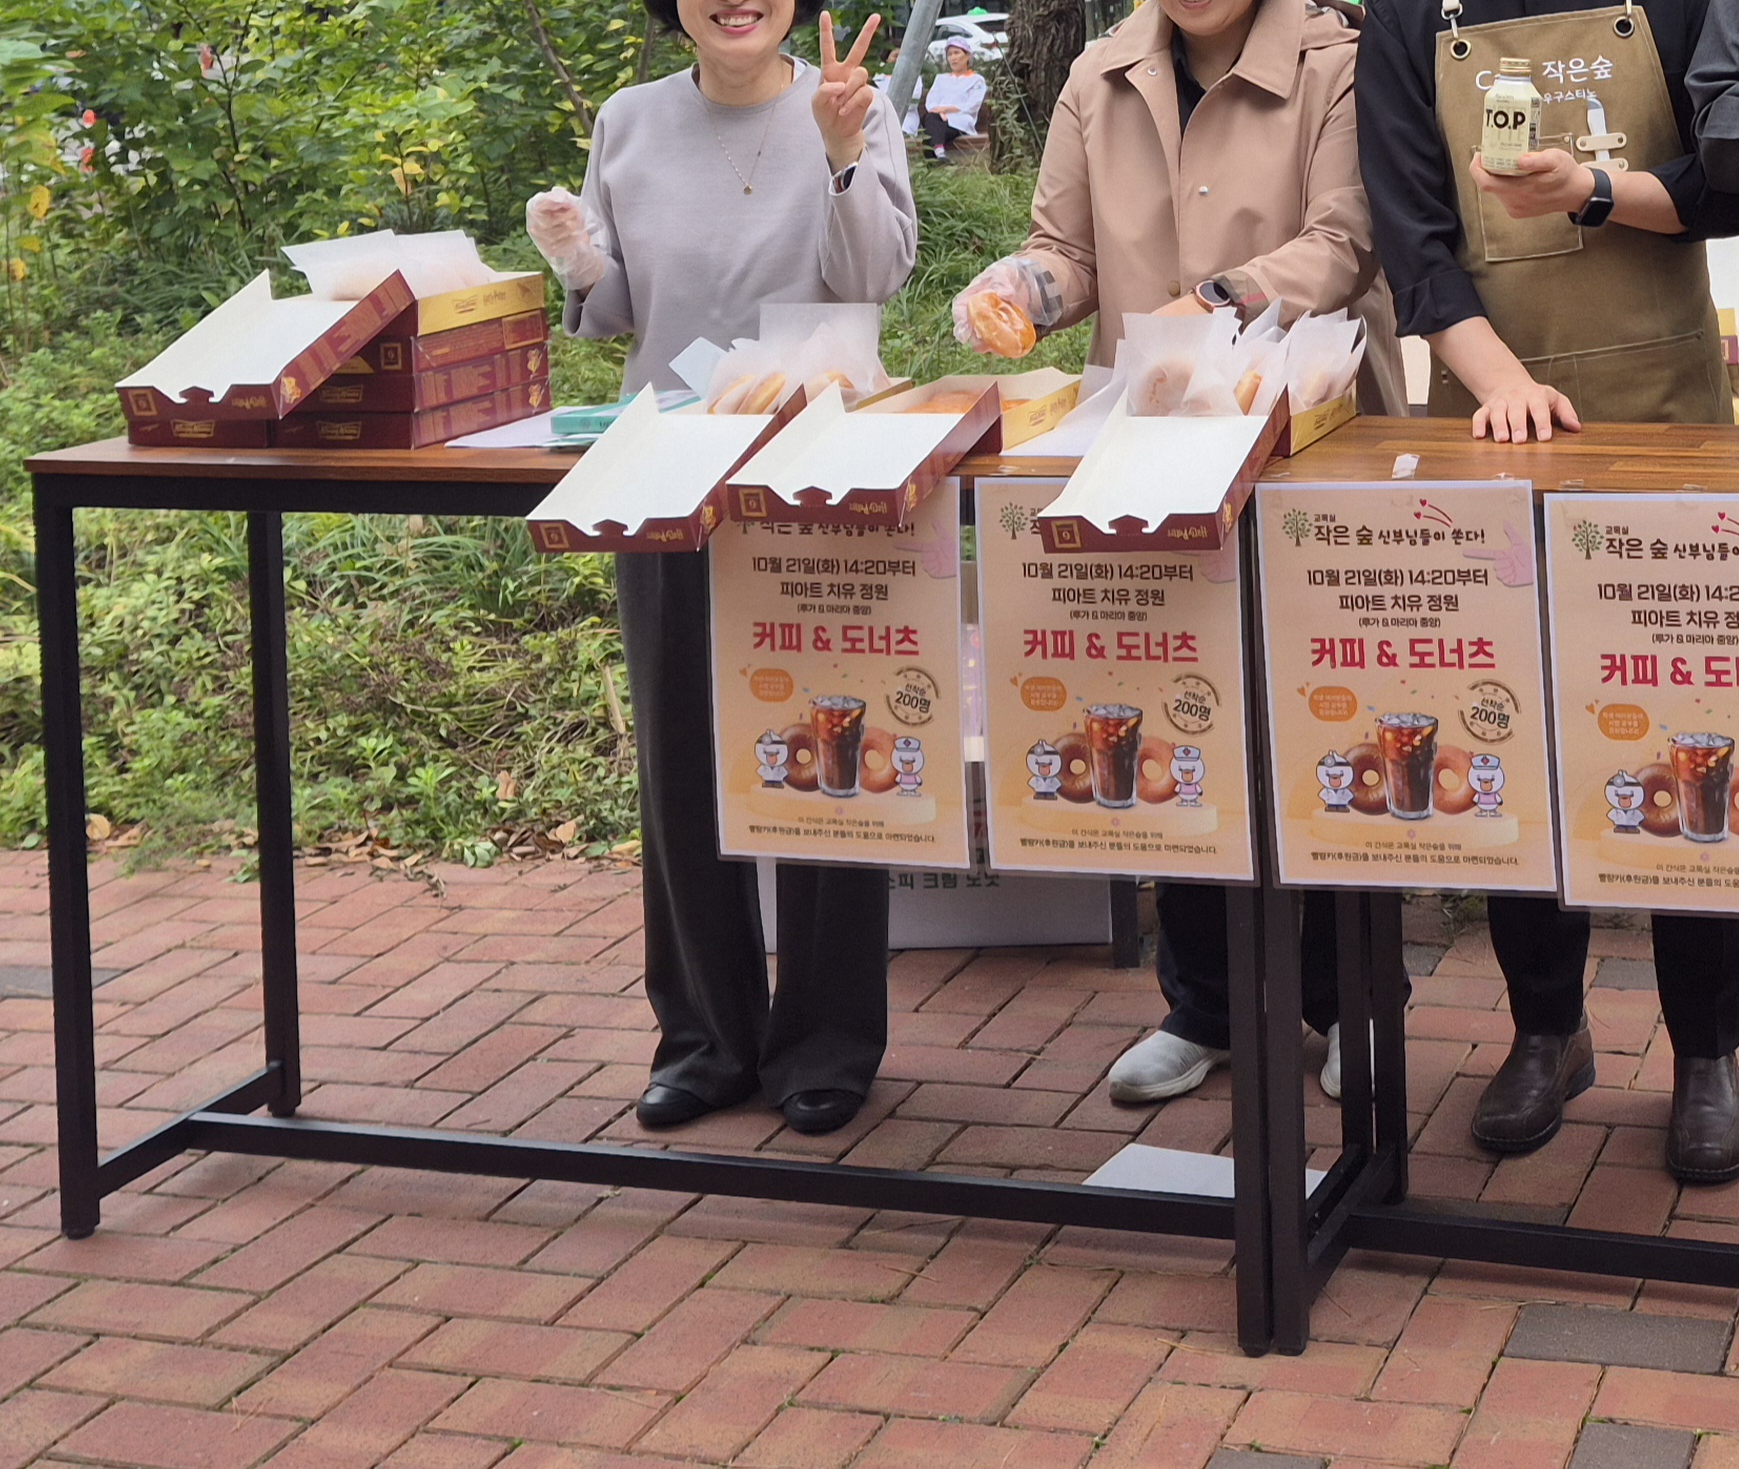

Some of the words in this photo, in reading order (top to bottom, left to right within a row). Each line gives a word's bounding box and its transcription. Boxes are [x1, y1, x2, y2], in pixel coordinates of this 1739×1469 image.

[1542, 54, 1613, 84] 작은숲
[1543, 89, 1598, 104] 우구스티노
[1486, 109, 1526, 130] T.O.P
[1314, 526, 1350, 545] 작은
[1356, 526, 1373, 545] 숲
[1378, 529, 1446, 546] 신부님들이
[1452, 529, 1485, 545] 쏜다!
[1605, 538, 1643, 560] 작은
[1650, 539, 1668, 560] 숲
[752, 557, 782, 573] 10월
[786, 558, 840, 574] 21일(화)
[844, 559, 915, 577] 14:20부터
[1022, 562, 1053, 578] 10월
[1058, 563, 1113, 581] 21일(화)
[1118, 565, 1193, 581] 14:20부터
[1307, 569, 1340, 586] 10월
[1344, 570, 1403, 587] 21일(화)
[1409, 570, 1488, 587] 14:20부터
[780, 582, 823, 598] 피아트
[827, 583, 855, 599] 치유
[859, 584, 888, 600] 정원
[1052, 588, 1096, 604] 피아트
[1101, 589, 1131, 605] 치유
[1135, 589, 1165, 606] 정원
[1597, 584, 1632, 601] 10월
[1637, 584, 1700, 602] 21일(화)
[826, 605, 850, 614] 마리아
[853, 606, 871, 615] 중앙)
[1339, 594, 1386, 612] 피아트
[1391, 595, 1422, 612] 치유
[1427, 596, 1459, 612] 정원
[1101, 612, 1125, 621] 마리아
[1128, 612, 1147, 621] 중앙)
[1391, 619, 1418, 628] 마리아
[1420, 619, 1441, 628] 중앙)
[1631, 610, 1681, 627] 피아트
[1686, 611, 1720, 628] 치유
[752, 622, 802, 652] 커피
[812, 625, 832, 651] &
[841, 625, 919, 656] 도너츠
[1023, 629, 1075, 660] 커피
[1086, 633, 1107, 659] &
[1116, 631, 1198, 663] 도너츠
[1686, 634, 1714, 645] 마리아
[1717, 635, 1739, 645] 중앙)
[1310, 638, 1365, 670] 커피
[1376, 640, 1399, 668] &
[1409, 638, 1496, 670] 도너츠
[1600, 653, 1660, 687] 커피
[1670, 656, 1694, 687] &
[905, 683, 926, 696] 선착순
[1184, 690, 1206, 704] 선착순
[895, 692, 931, 713] 200명
[1173, 699, 1211, 722] 200명
[1481, 698, 1505, 711] 선착순
[1471, 706, 1510, 729] 200명
[1662, 876, 1694, 886] 보내주신
[1697, 878, 1721, 887] 분들의
